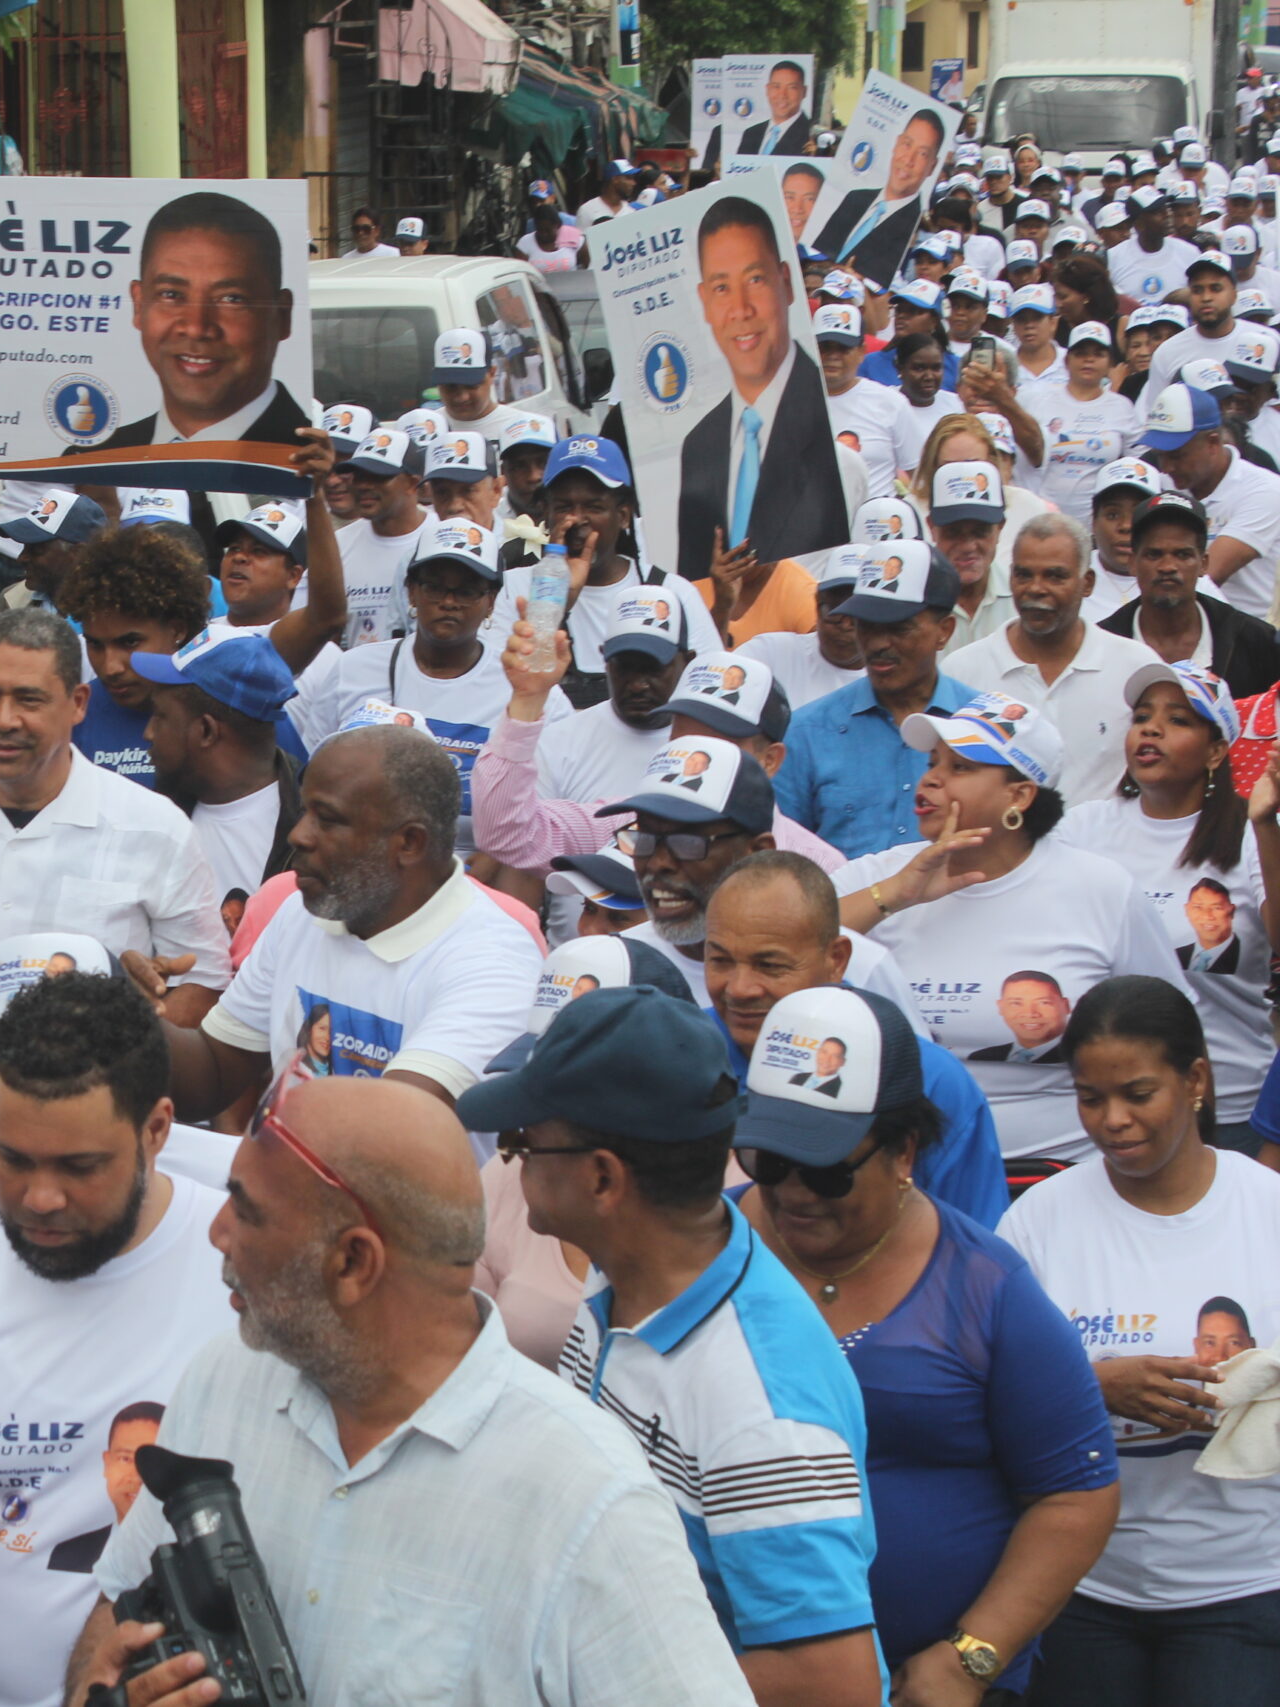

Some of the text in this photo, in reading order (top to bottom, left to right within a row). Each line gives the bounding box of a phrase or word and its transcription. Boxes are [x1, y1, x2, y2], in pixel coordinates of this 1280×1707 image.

[41, 220, 132, 254] LIZ
[650, 227, 684, 253] LIZ
[617, 248, 680, 278] DIPUTADO
[99, 294, 121, 310] #1
[49, 316, 109, 333] ESTE
[117, 762, 156, 774] Núñez
[553, 975, 576, 987] LIZ
[938, 983, 982, 994] LIZ
[791, 1034, 820, 1050] LIZ
[1117, 1314, 1158, 1331] LIZ
[1082, 1331, 1154, 1347] IPUTADO
[29, 1422, 84, 1441] LIZ
